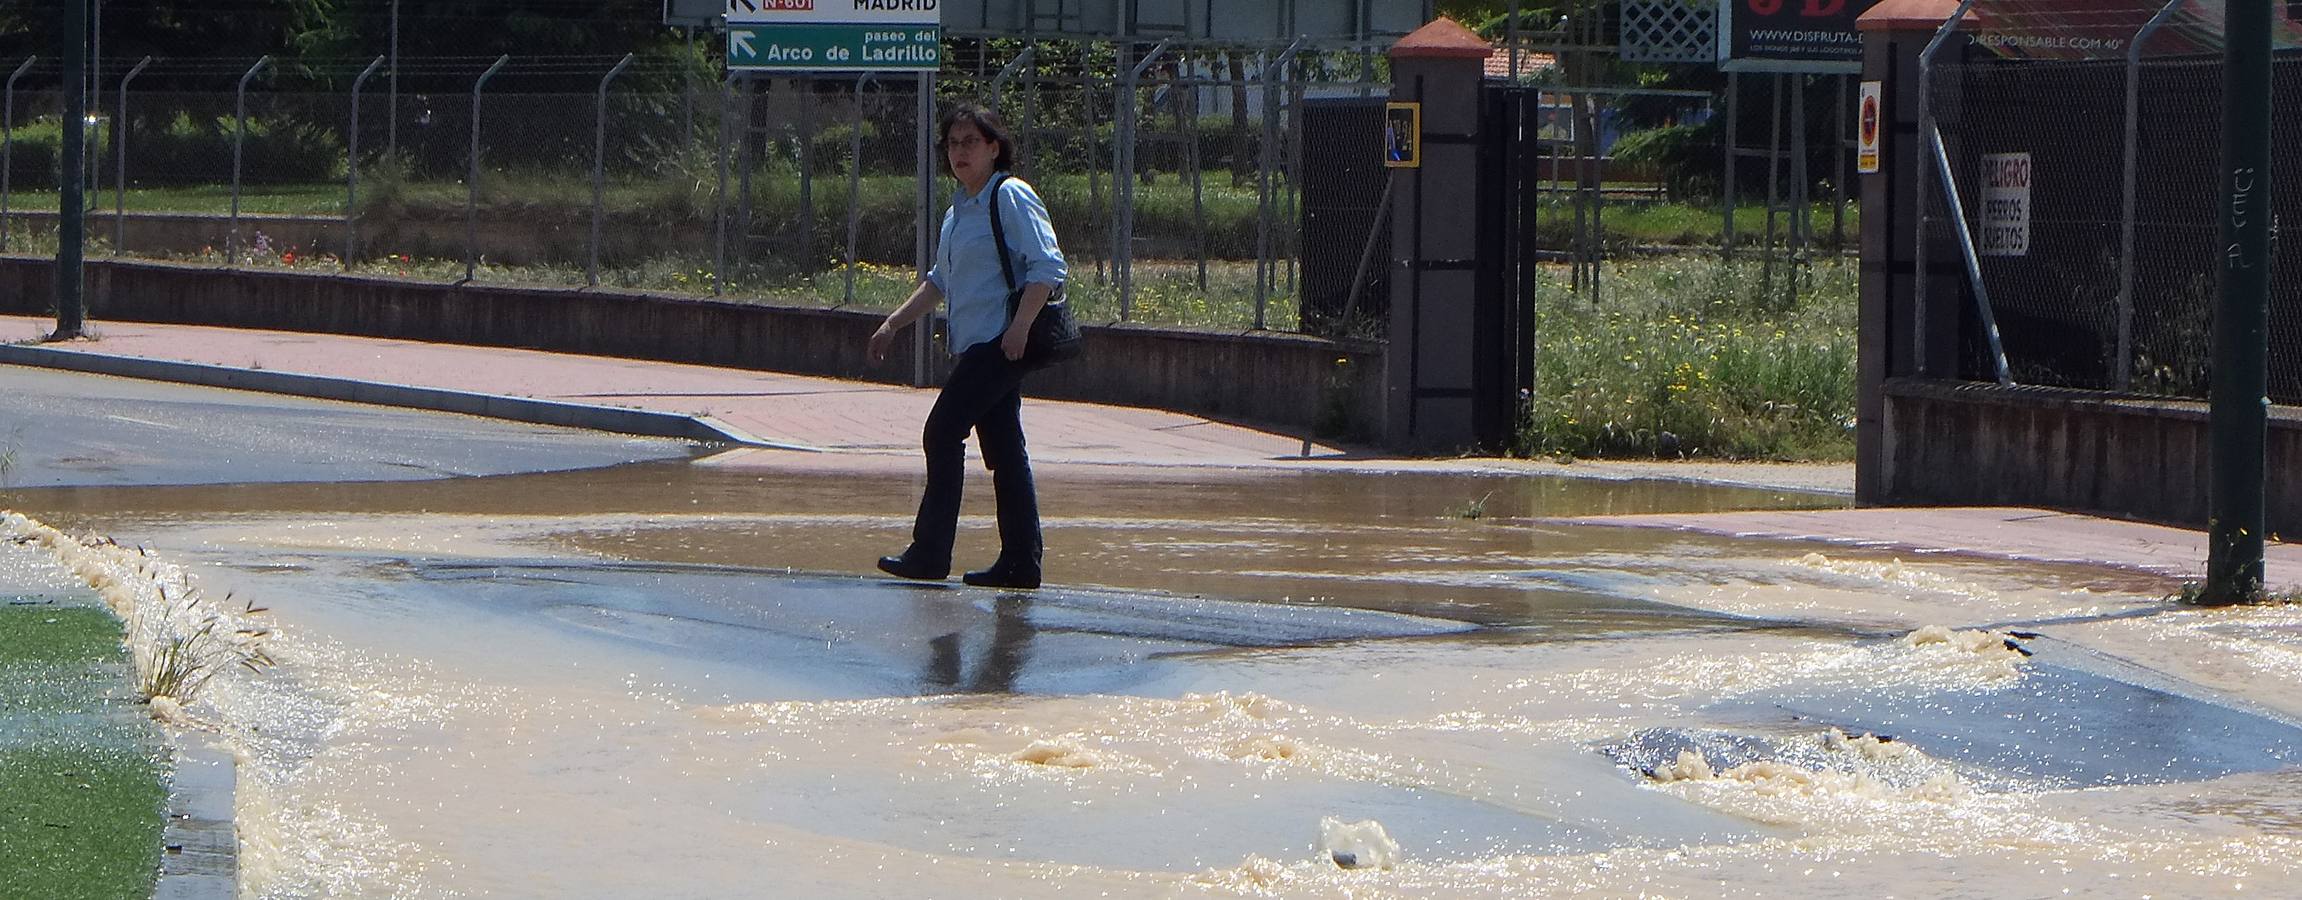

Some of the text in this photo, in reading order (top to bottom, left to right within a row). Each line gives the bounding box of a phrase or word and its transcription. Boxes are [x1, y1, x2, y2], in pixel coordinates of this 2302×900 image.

[853, 0, 936, 10] MADRID
[865, 30, 936, 43] paseo del
[767, 44, 937, 62] Arco de Ladrillo
